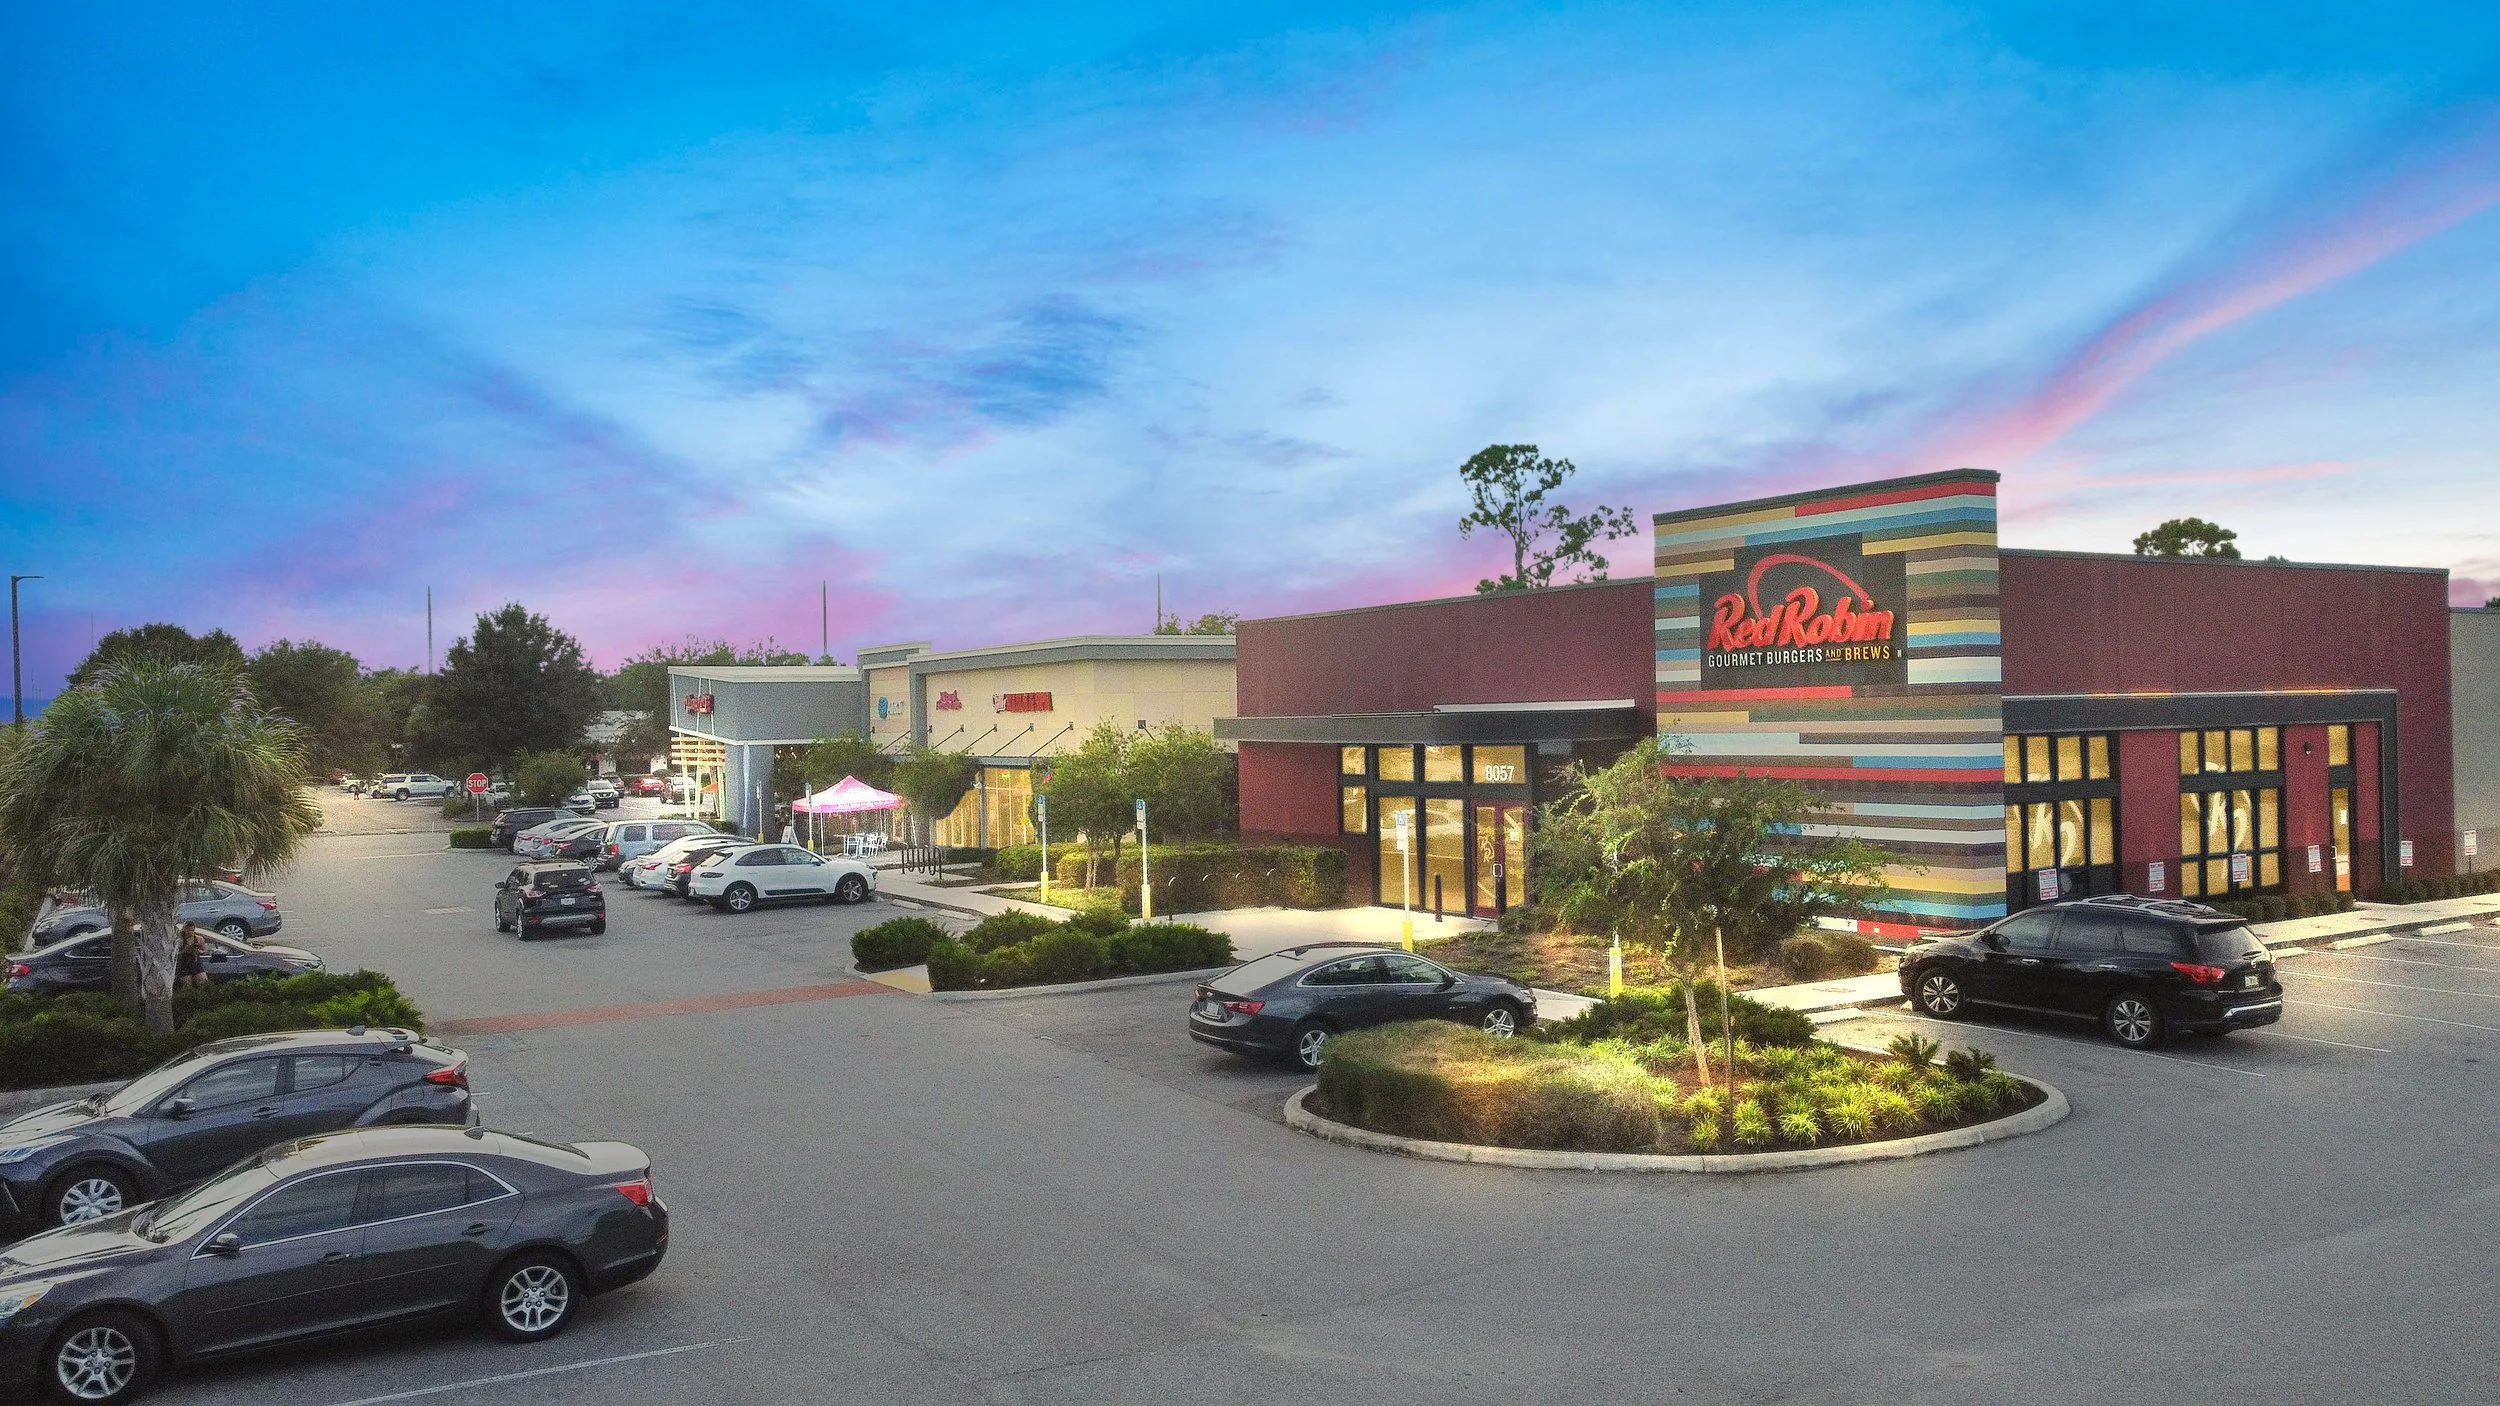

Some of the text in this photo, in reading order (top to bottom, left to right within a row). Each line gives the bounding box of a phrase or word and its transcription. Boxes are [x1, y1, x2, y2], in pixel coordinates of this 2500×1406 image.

[1707, 586, 1894, 652] Red Robin
[1708, 645, 1890, 667] GOURMET BURGERS AND BREWS
[1485, 765, 1514, 781] 8057
[468, 779, 487, 787] STOP
